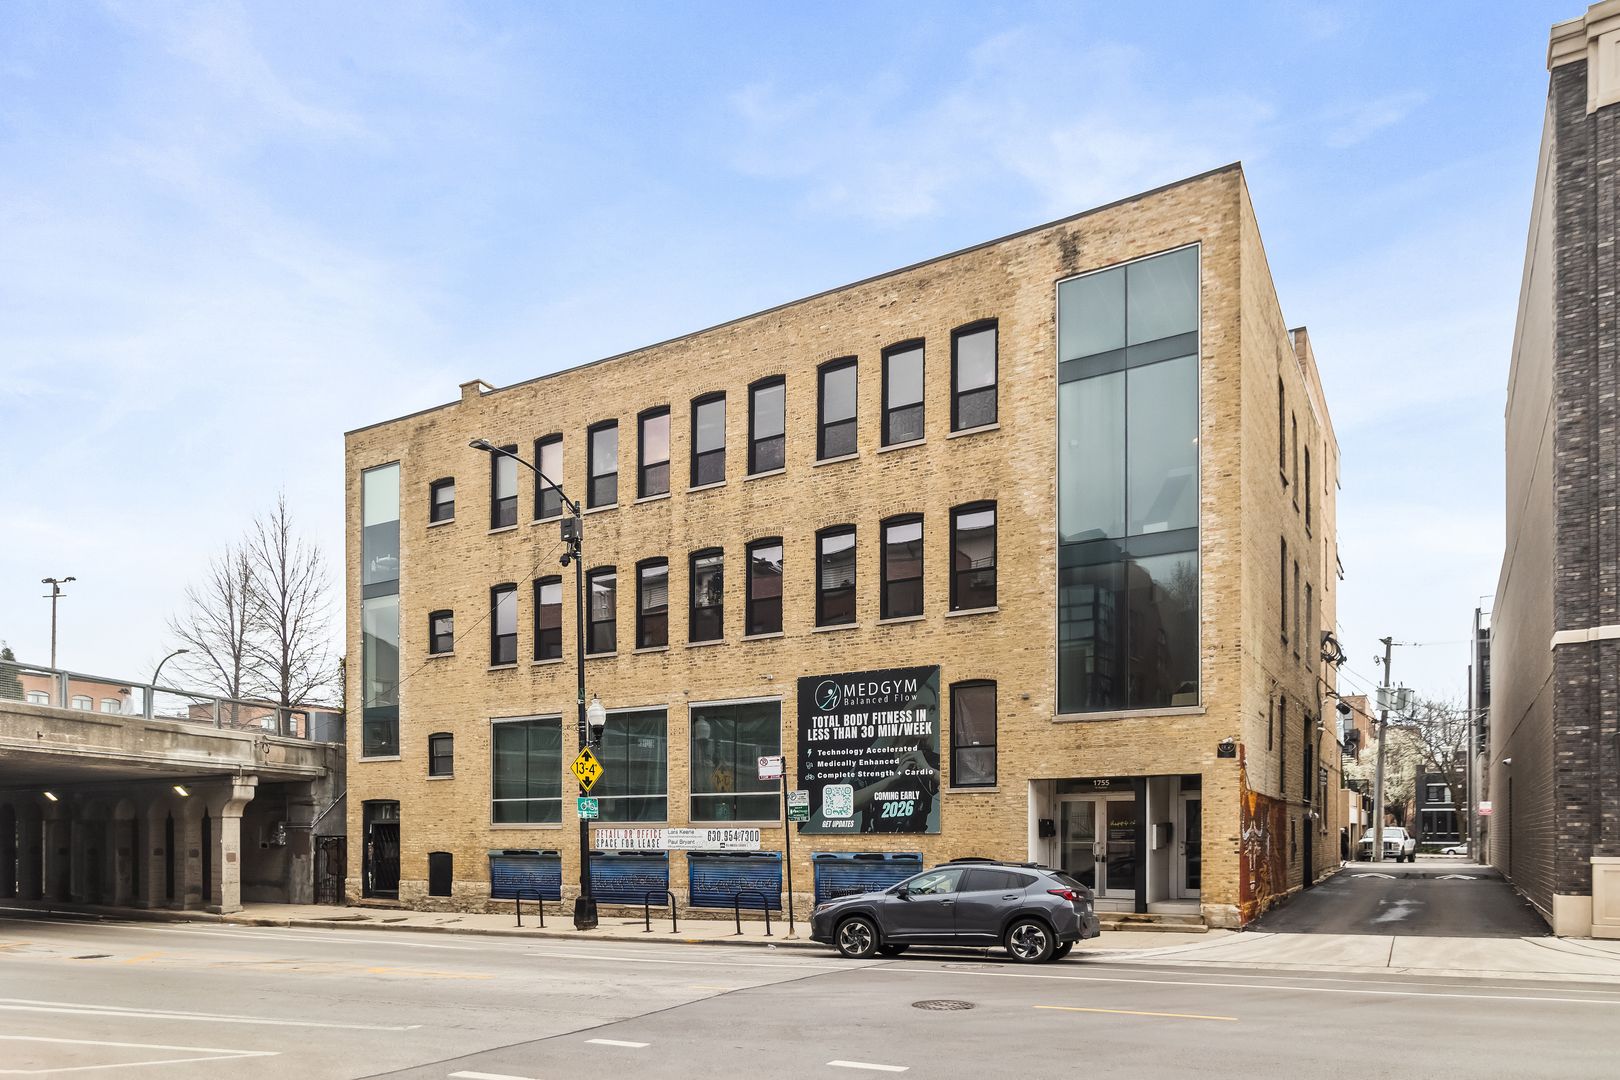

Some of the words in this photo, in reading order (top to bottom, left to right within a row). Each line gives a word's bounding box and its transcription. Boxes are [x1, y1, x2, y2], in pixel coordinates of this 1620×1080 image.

[843, 678, 917, 697] MEDGYM
[844, 694, 889, 706] Balanced
[894, 693, 918, 702] Flow
[812, 715, 840, 728] TOTAL
[843, 713, 869, 726] BODY
[872, 710, 913, 724] FITNESS
[916, 709, 927, 721] IN
[807, 728, 830, 741] LESS
[833, 726, 858, 739] THAN
[861, 725, 875, 738] 30
[878, 721, 932, 737] MIN/WEEK
[817, 748, 864, 756] Technology
[866, 745, 918, 754] Accelerated
[859, 758, 900, 766] Enhanced
[817, 771, 856, 780] Complete
[858, 769, 895, 778] Strength
[874, 791, 899, 800] COMING
[900, 791, 920, 800] EARLY
[881, 800, 915, 818] 2026
[597, 830, 620, 838] RETAIL
[624, 829, 633, 838] OR
[636, 829, 662, 838] OFFICE
[708, 830, 760, 842] 630.954.7300
[596, 839, 617, 848] SPACE
[621, 839, 634, 848] FOR
[638, 839, 660, 848] LEASE
